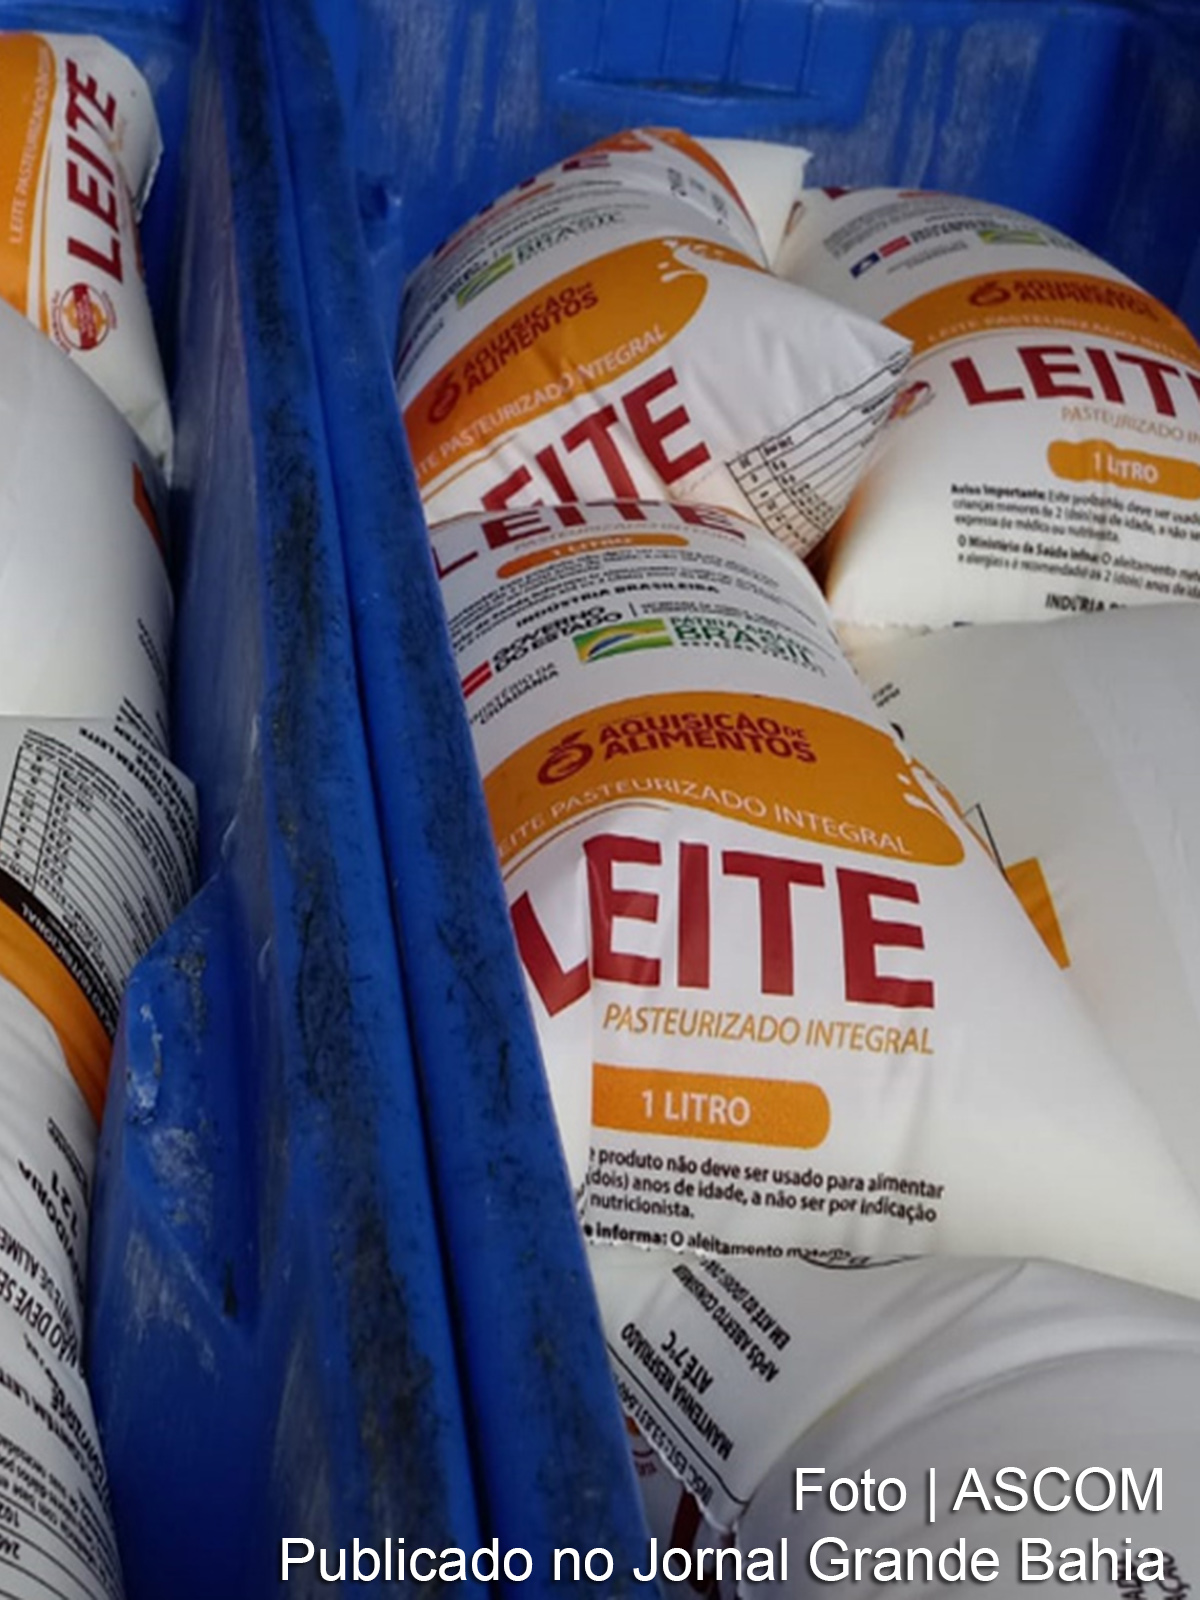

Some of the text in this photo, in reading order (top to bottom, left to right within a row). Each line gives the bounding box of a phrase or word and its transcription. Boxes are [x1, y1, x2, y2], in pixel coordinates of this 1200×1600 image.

[65, 58, 123, 284] LEITE
[465, 288, 600, 396] ALIMENTOS
[950, 344, 1200, 419] LEIT
[1061, 406, 1185, 444] PASTEURIZADO
[492, 605, 606, 664] GOVERNO
[494, 612, 623, 673] DO ESTADO
[604, 730, 818, 764] ALIMENTOS
[782, 724, 807, 740] DE
[549, 777, 914, 856] PASTEURIZADO INTEGRAL
[510, 832, 936, 1018] LEITE
[602, 1002, 935, 1055] PASTEURIZADO INTEGRAL
[641, 1090, 751, 1127] 1 LITRO
[585, 1169, 937, 1225] (dois) anos de idade, a não ser por indicação
[598, 1149, 945, 1200] produto não deve ser usado para alimentar
[590, 1194, 695, 1219] nutricionista.
[596, 1222, 667, 1245] informa:
[670, 1230, 684, 1247] O
[14, 1287, 52, 1338] DEVE
[750, 1308, 792, 1351] EM ATÉ
[712, 1306, 780, 1383] APÓS ABERTO
[621, 1322, 734, 1462] MANTENHA RESFRIADO
[681, 1354, 714, 1395] ATÉ
